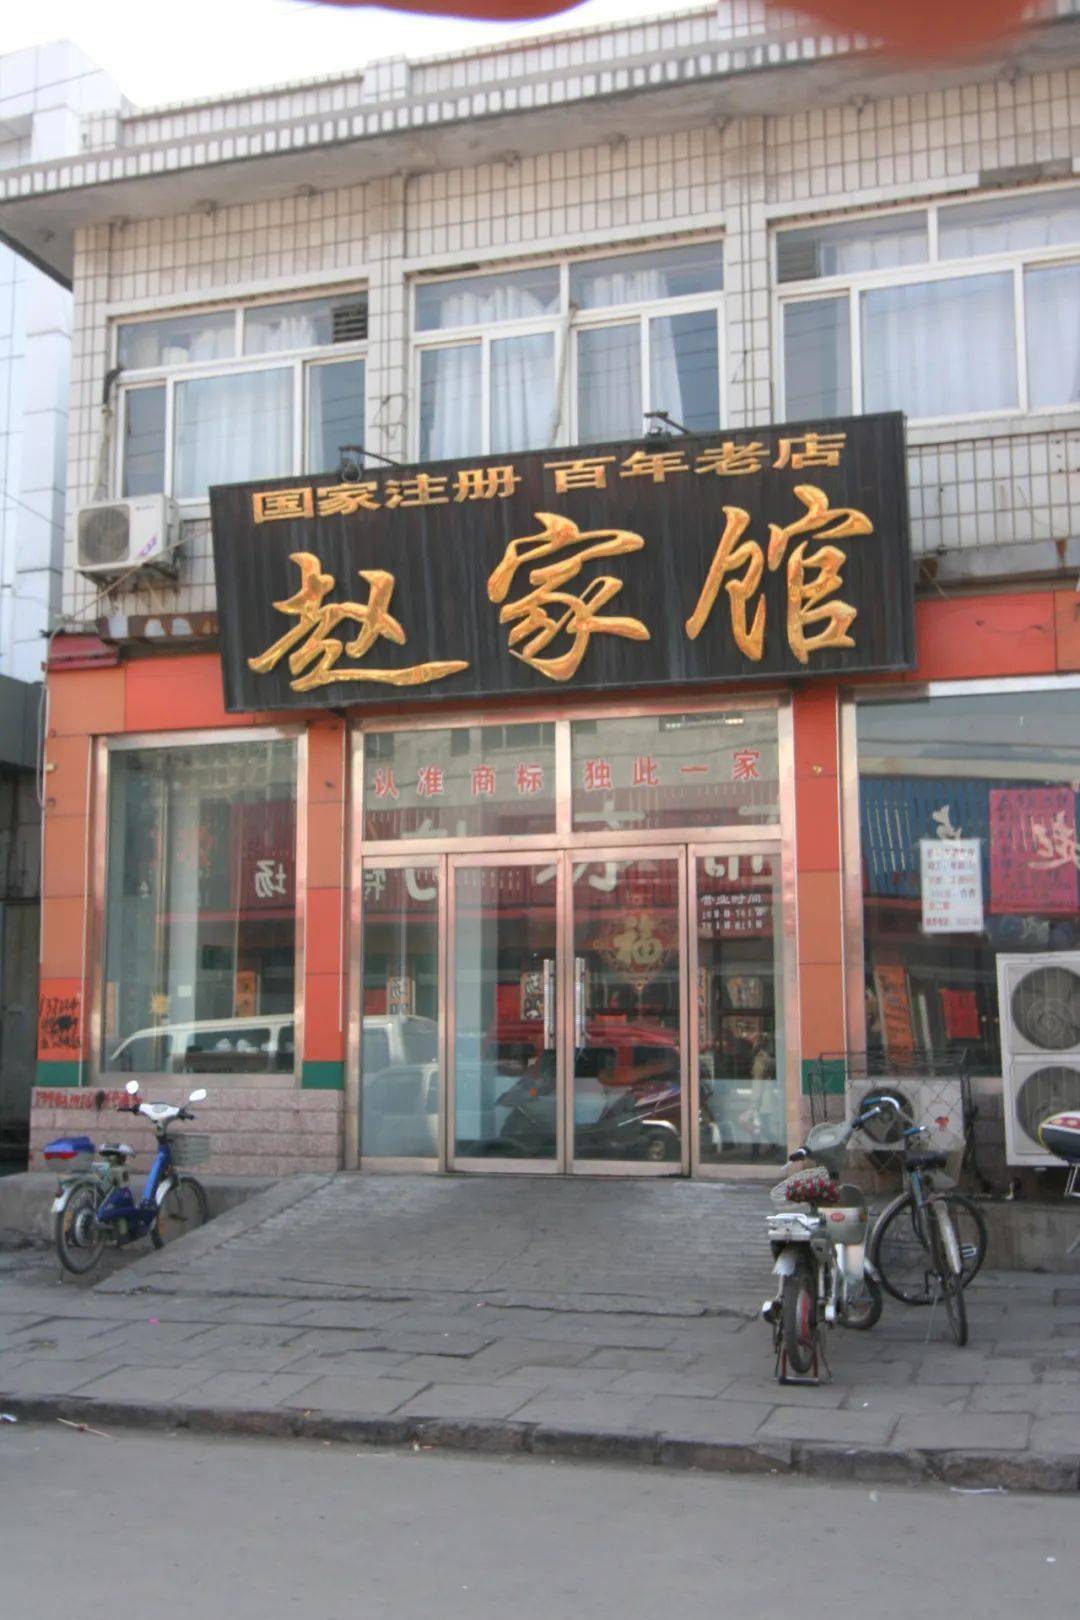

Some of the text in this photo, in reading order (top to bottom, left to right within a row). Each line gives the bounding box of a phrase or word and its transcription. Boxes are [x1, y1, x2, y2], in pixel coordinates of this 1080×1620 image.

[252, 432, 848, 525] 国家注册 百年老店
[247, 484, 874, 692] 赵家馆
[373, 748, 762, 798] 认准商标 独此一家
